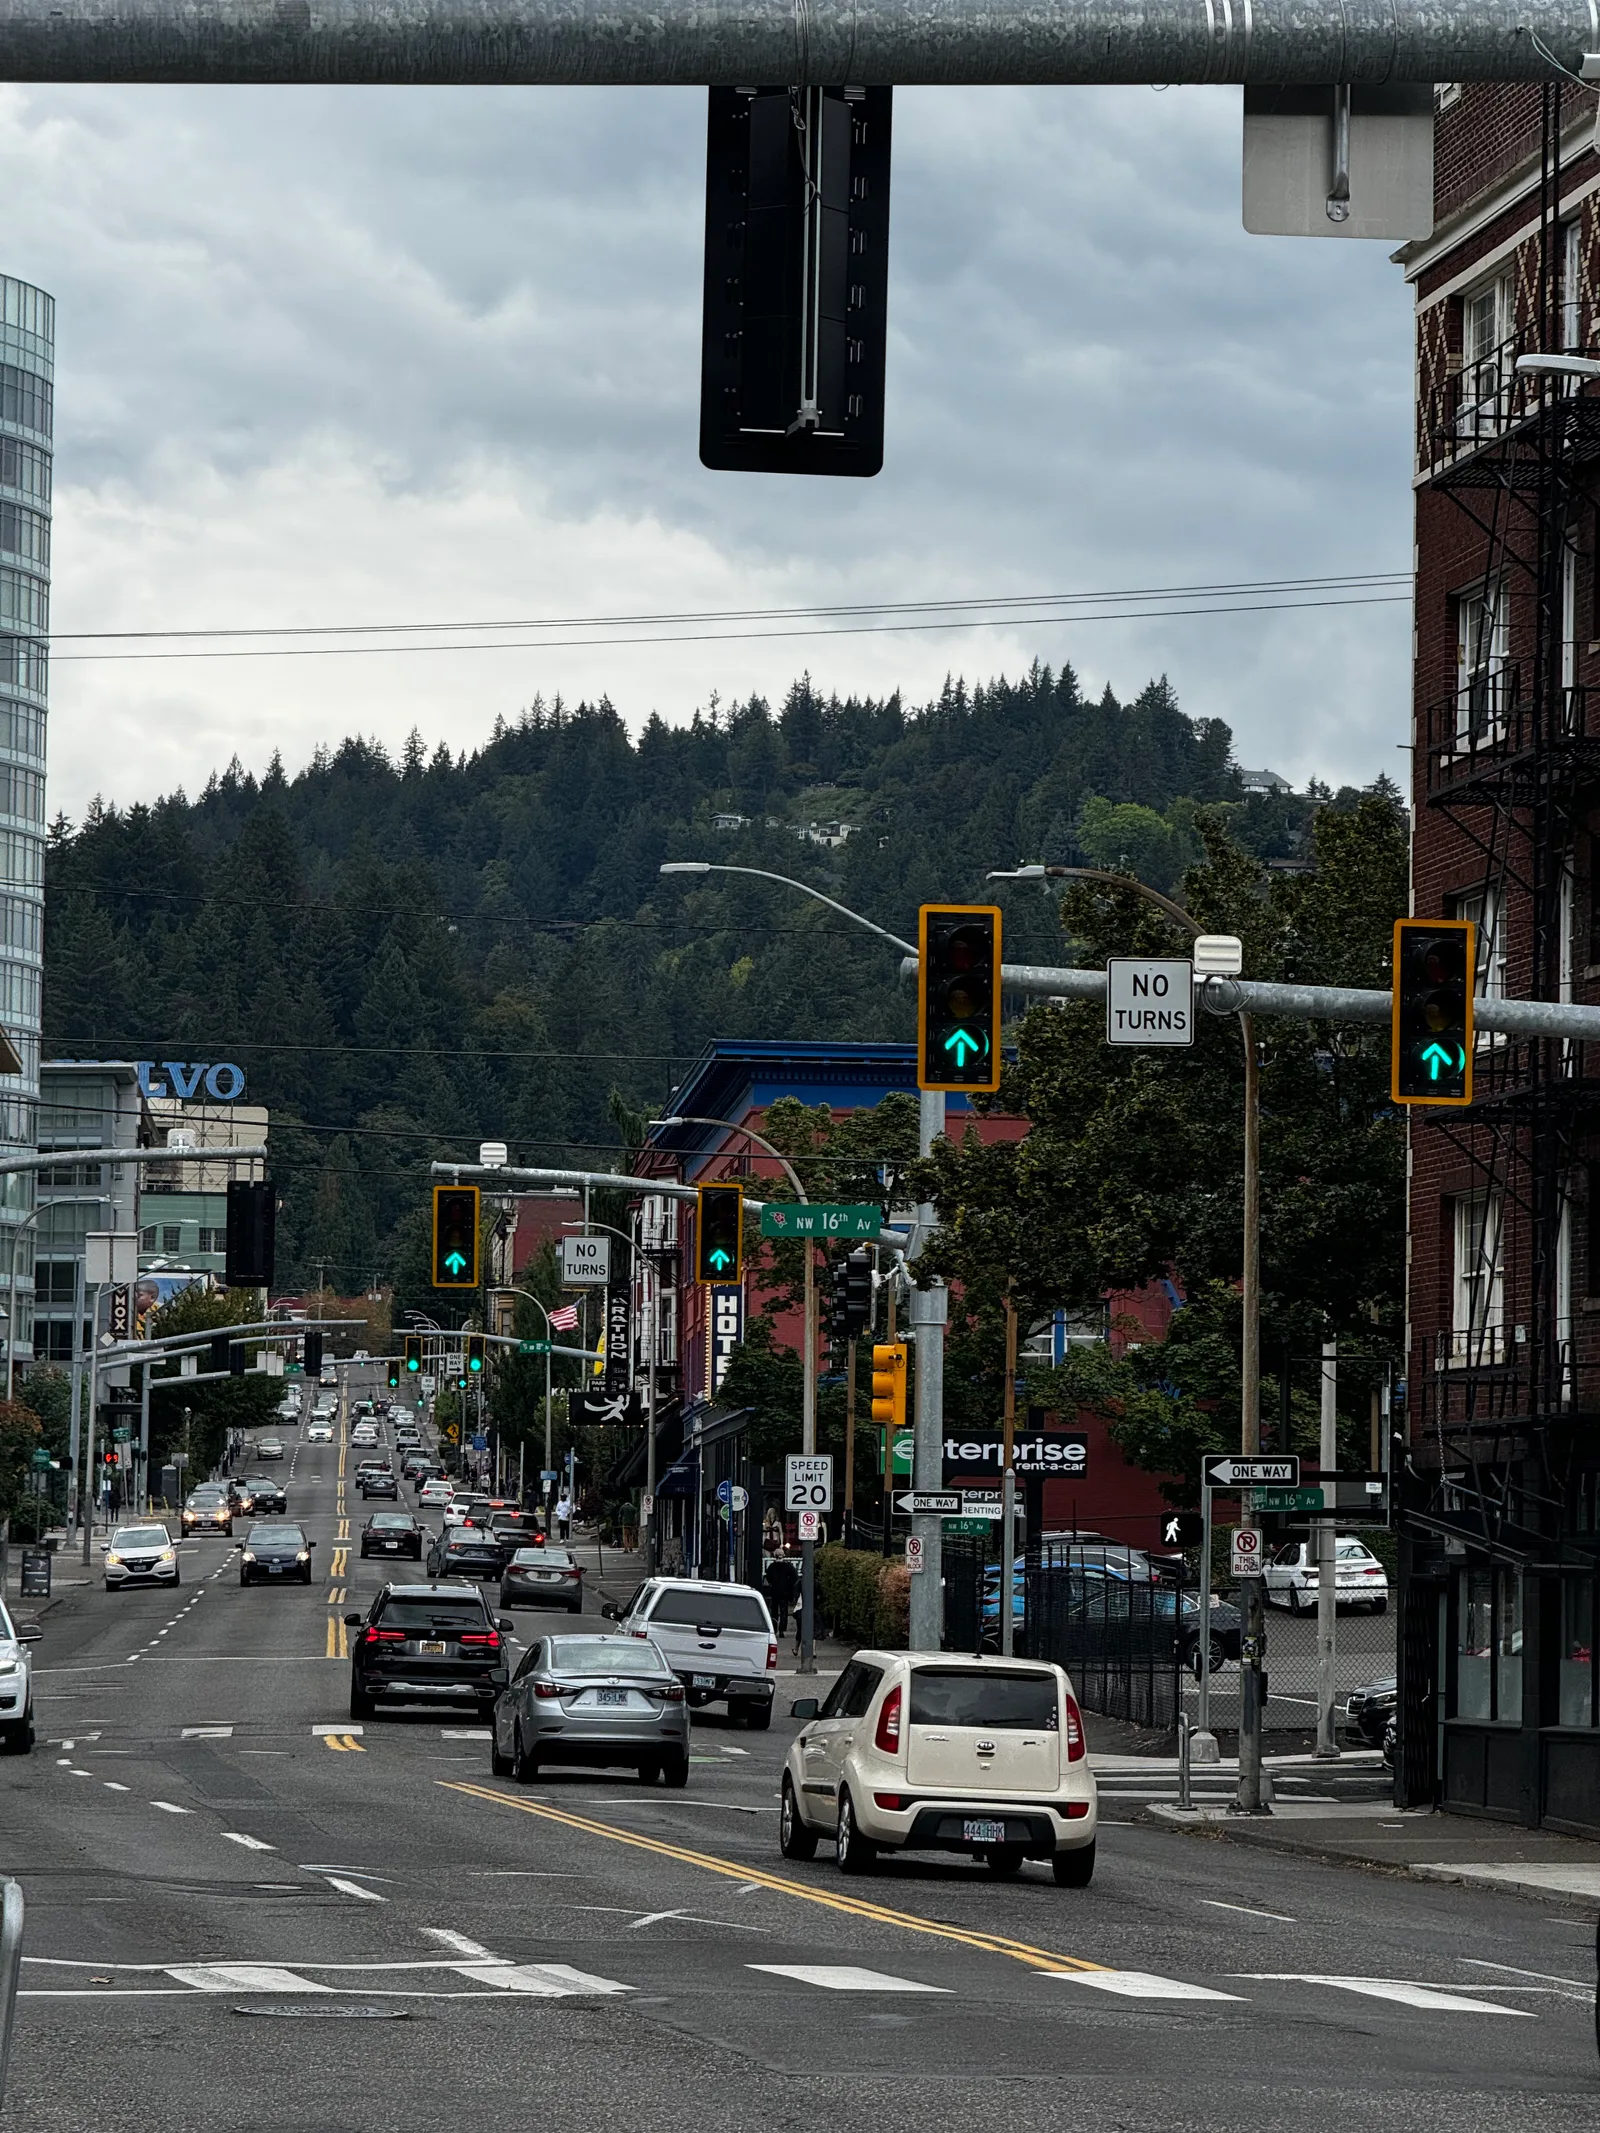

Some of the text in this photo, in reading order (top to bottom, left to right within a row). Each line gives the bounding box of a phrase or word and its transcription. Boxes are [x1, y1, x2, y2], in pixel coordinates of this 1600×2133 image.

[1132, 974, 1169, 997] NO
[1115, 1010, 1187, 1030] TURNS
[797, 1212, 871, 1231] NW 16th Av
[576, 1244, 597, 1258] NO
[566, 1264, 606, 1276] TURNS
[791, 1461, 828, 1470] SPEED
[1016, 1461, 1086, 1471] rent-a-car
[1232, 1466, 1288, 1477] ONE WAY
[794, 1473, 824, 1482] LIMIT
[791, 1485, 827, 1504] 20
[913, 1499, 955, 1508] ONE WAY
[1269, 1497, 1280, 1506] NW
[1306, 1496, 1316, 1505] Av
[1239, 1556, 1255, 1564] THIS
[964, 1822, 1004, 1838] 444 HHK
